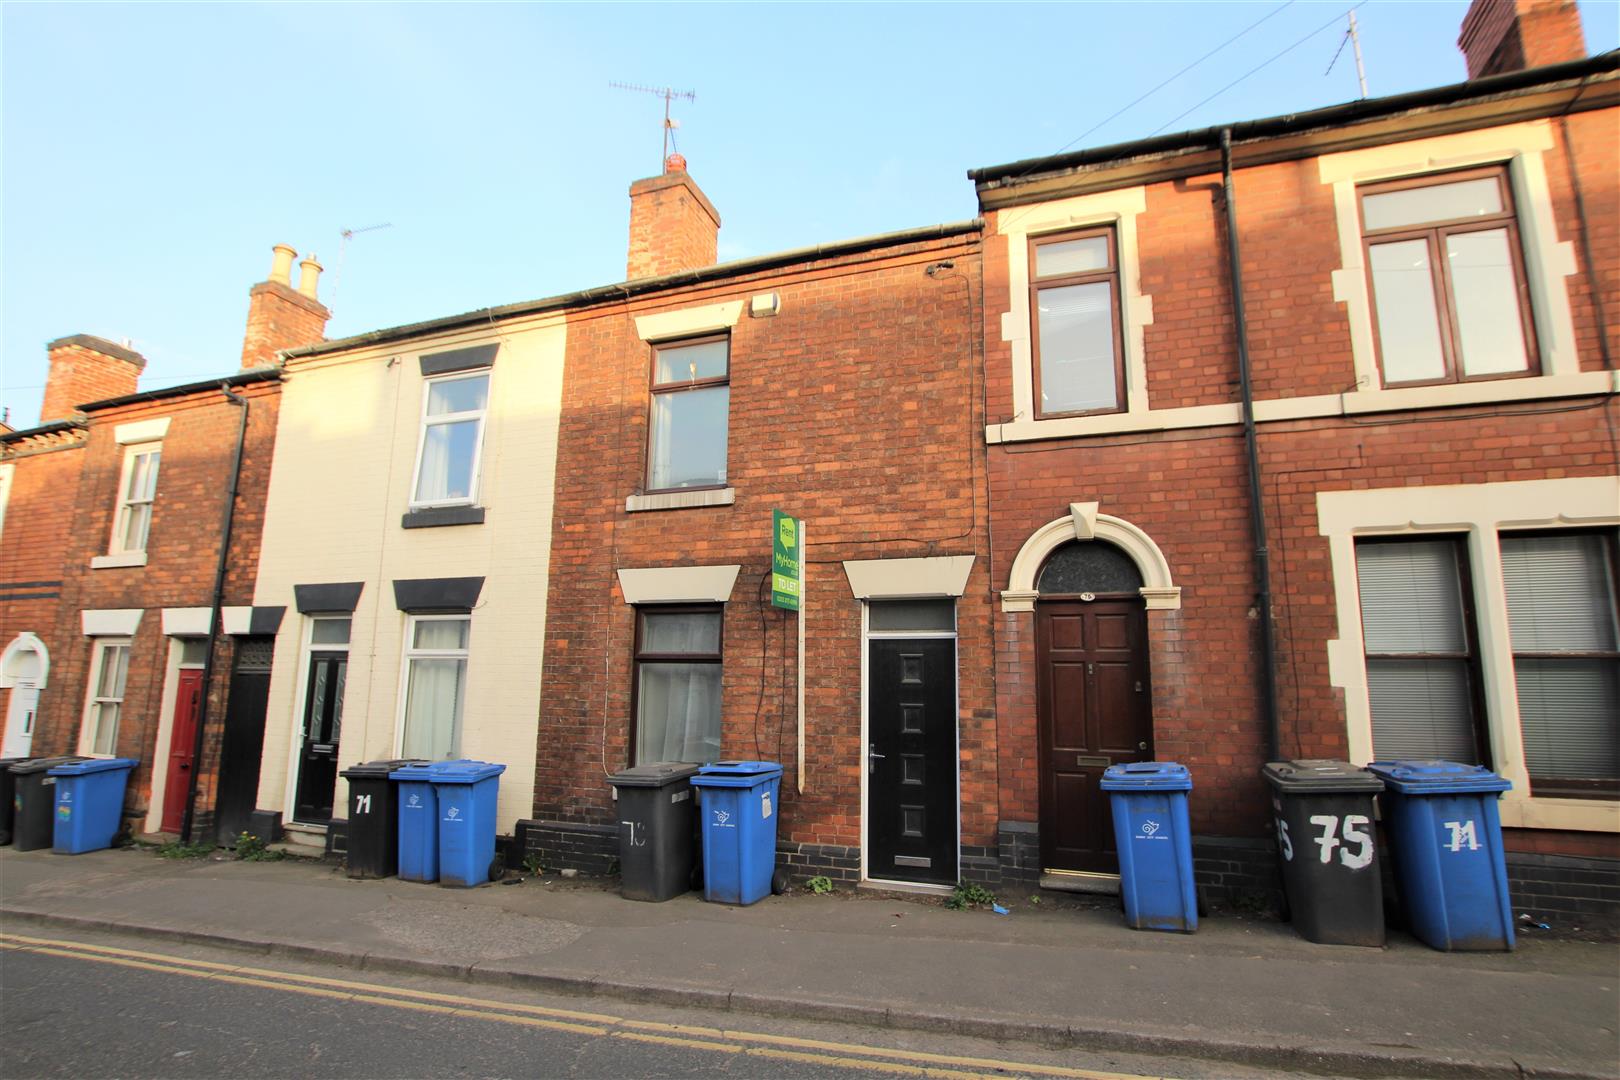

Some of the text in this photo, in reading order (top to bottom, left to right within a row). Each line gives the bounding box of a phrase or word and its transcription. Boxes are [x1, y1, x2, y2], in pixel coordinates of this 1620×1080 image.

[782, 524, 794, 539] Rent
[778, 578, 796, 592] TO LET
[356, 795, 371, 814] 71
[1310, 815, 1373, 869] 75
[1444, 820, 1477, 851] 71
